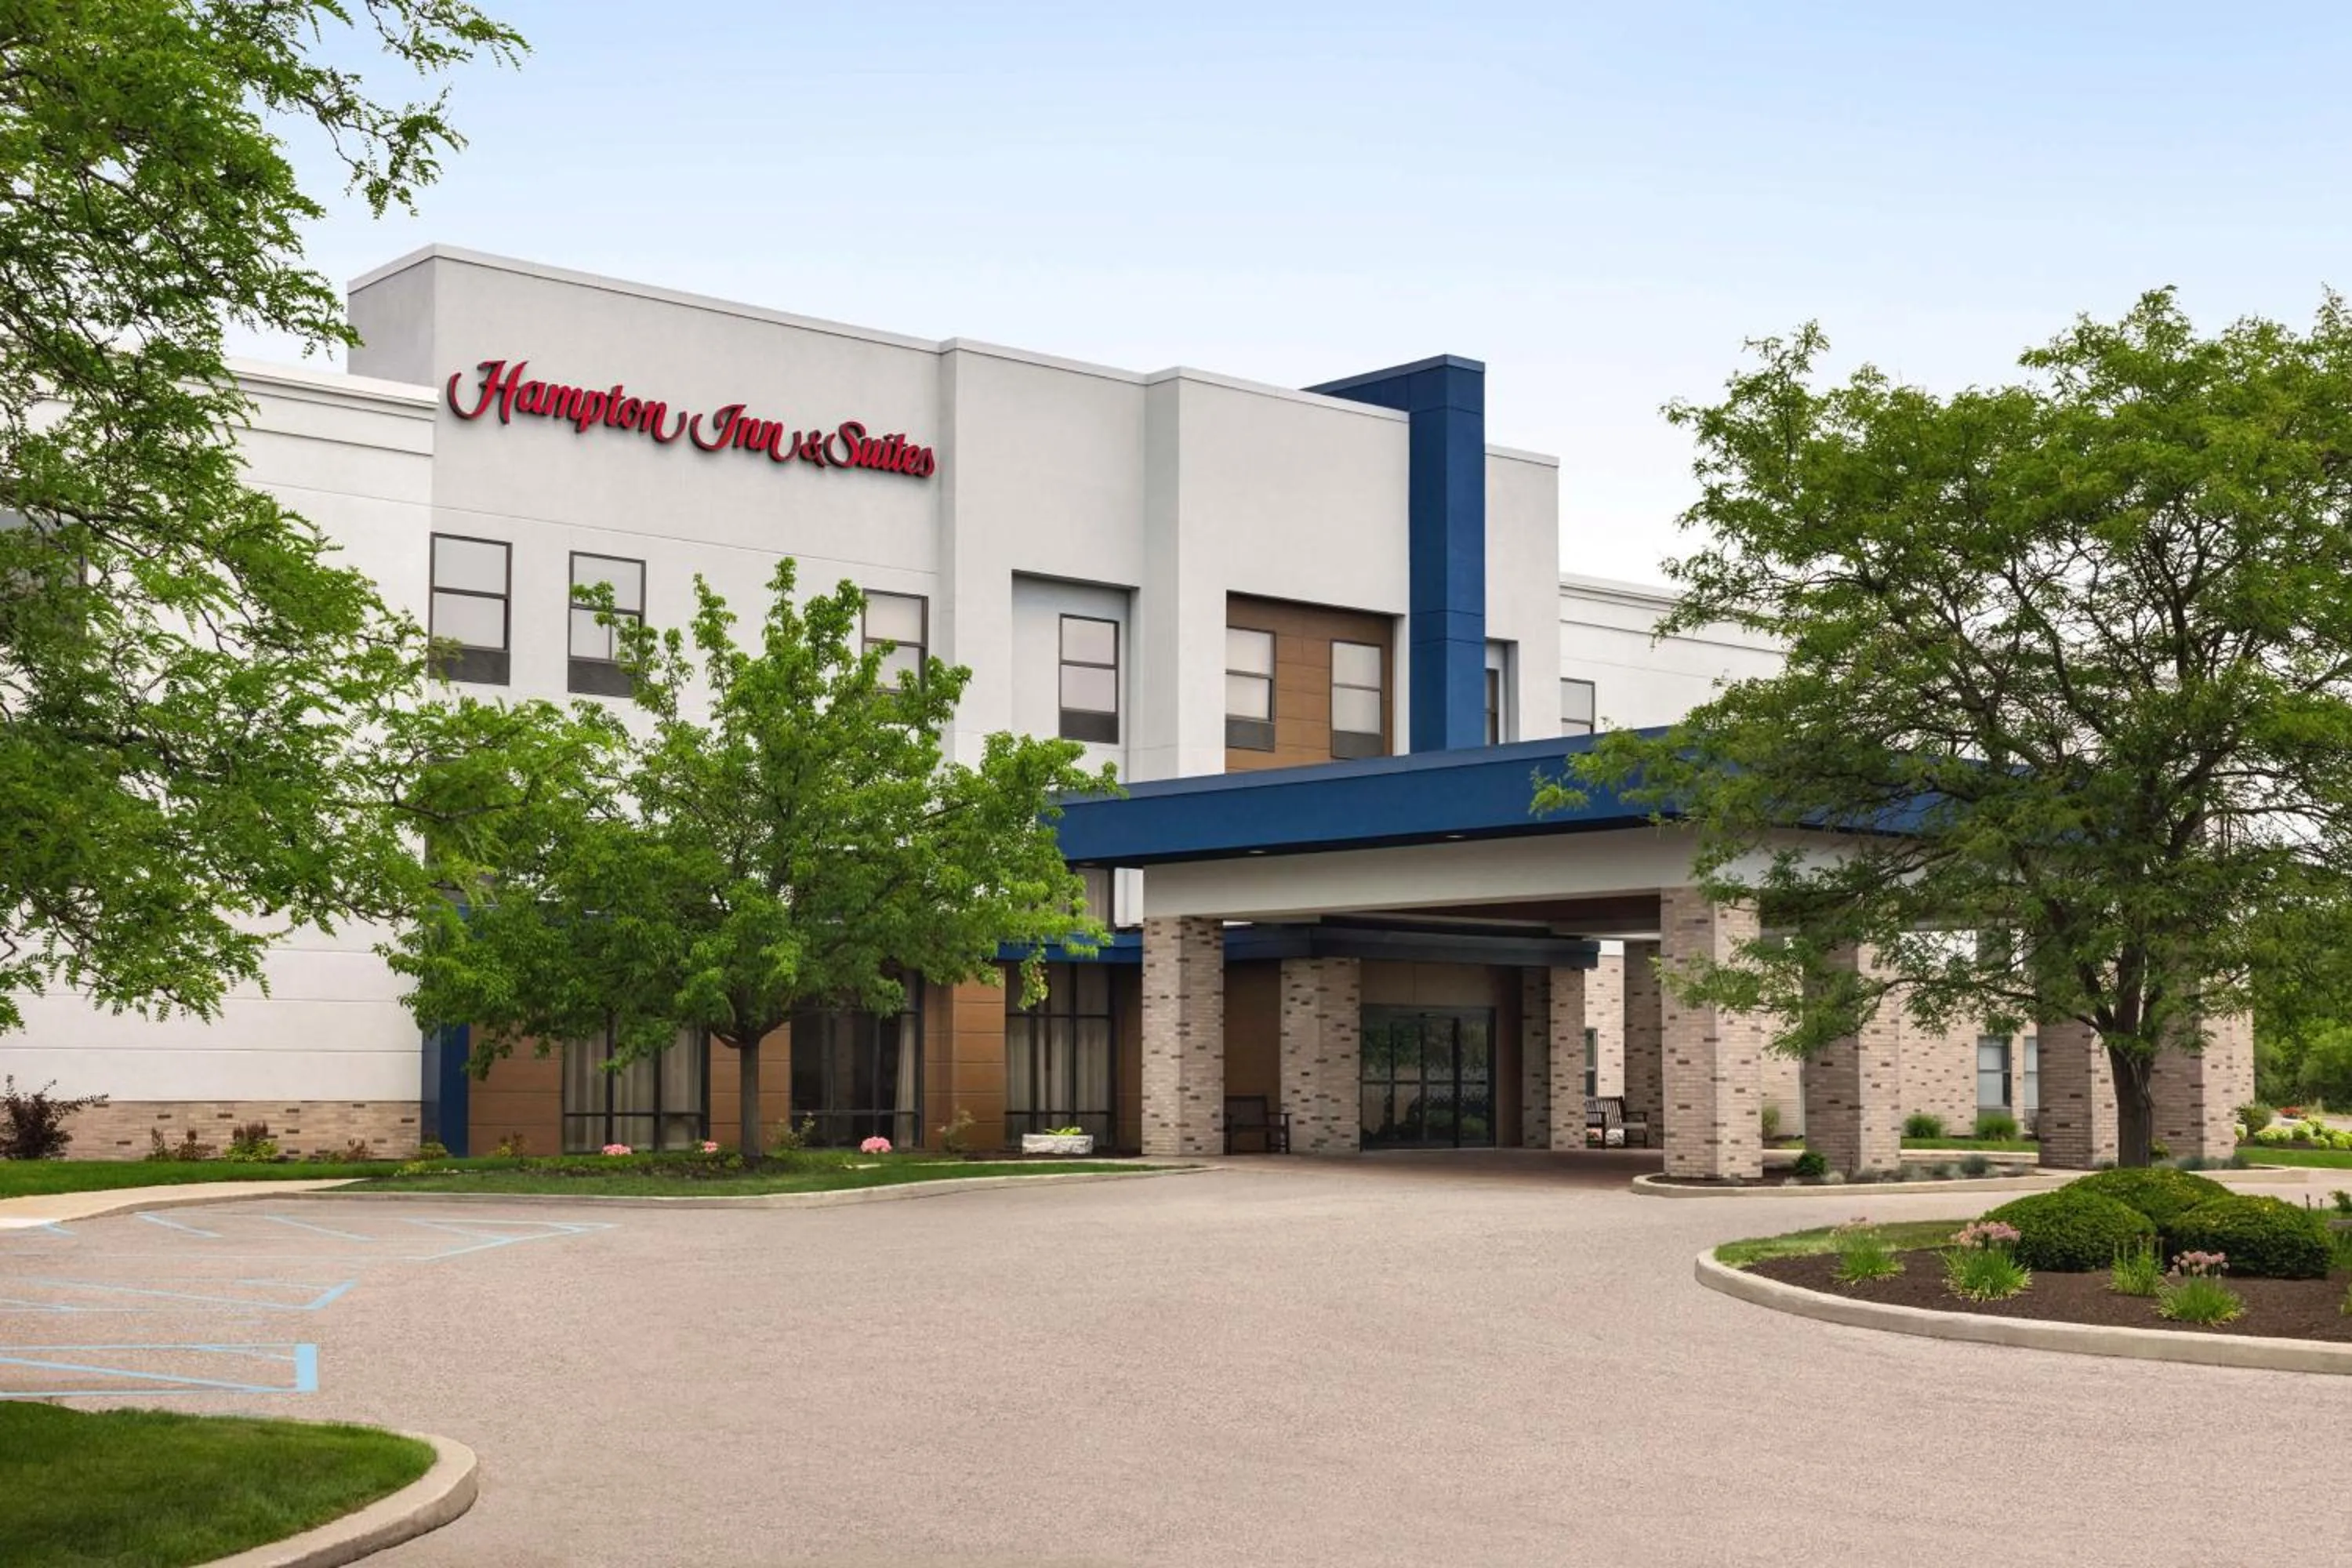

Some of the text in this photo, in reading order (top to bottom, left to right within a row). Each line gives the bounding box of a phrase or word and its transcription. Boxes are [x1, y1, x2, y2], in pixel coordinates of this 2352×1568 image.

[447, 360, 688, 444] Hampton
[689, 404, 802, 463] Inn
[823, 421, 935, 478] Suites
